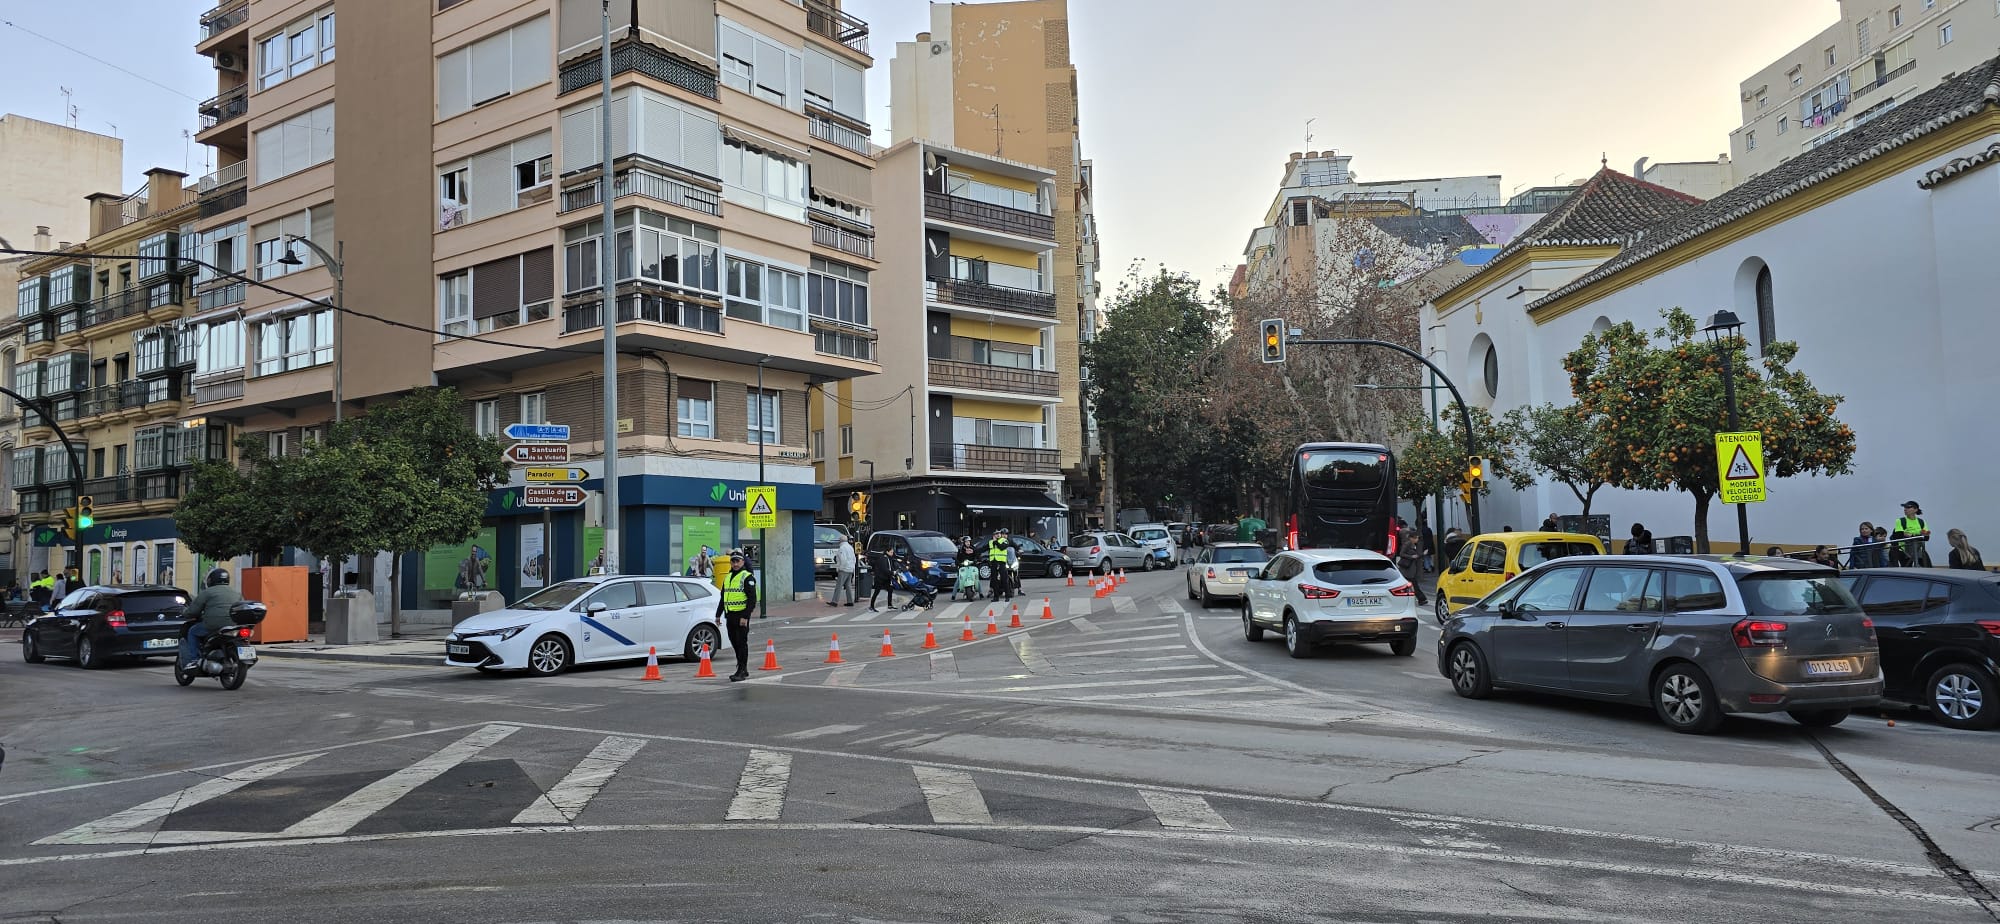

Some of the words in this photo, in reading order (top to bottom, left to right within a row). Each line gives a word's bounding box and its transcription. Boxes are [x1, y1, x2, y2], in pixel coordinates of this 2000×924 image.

[1727, 487, 1762, 495] VELOCIDAD
[1811, 662, 1833, 673] 0112
[1833, 661, 1849, 672] LSD
